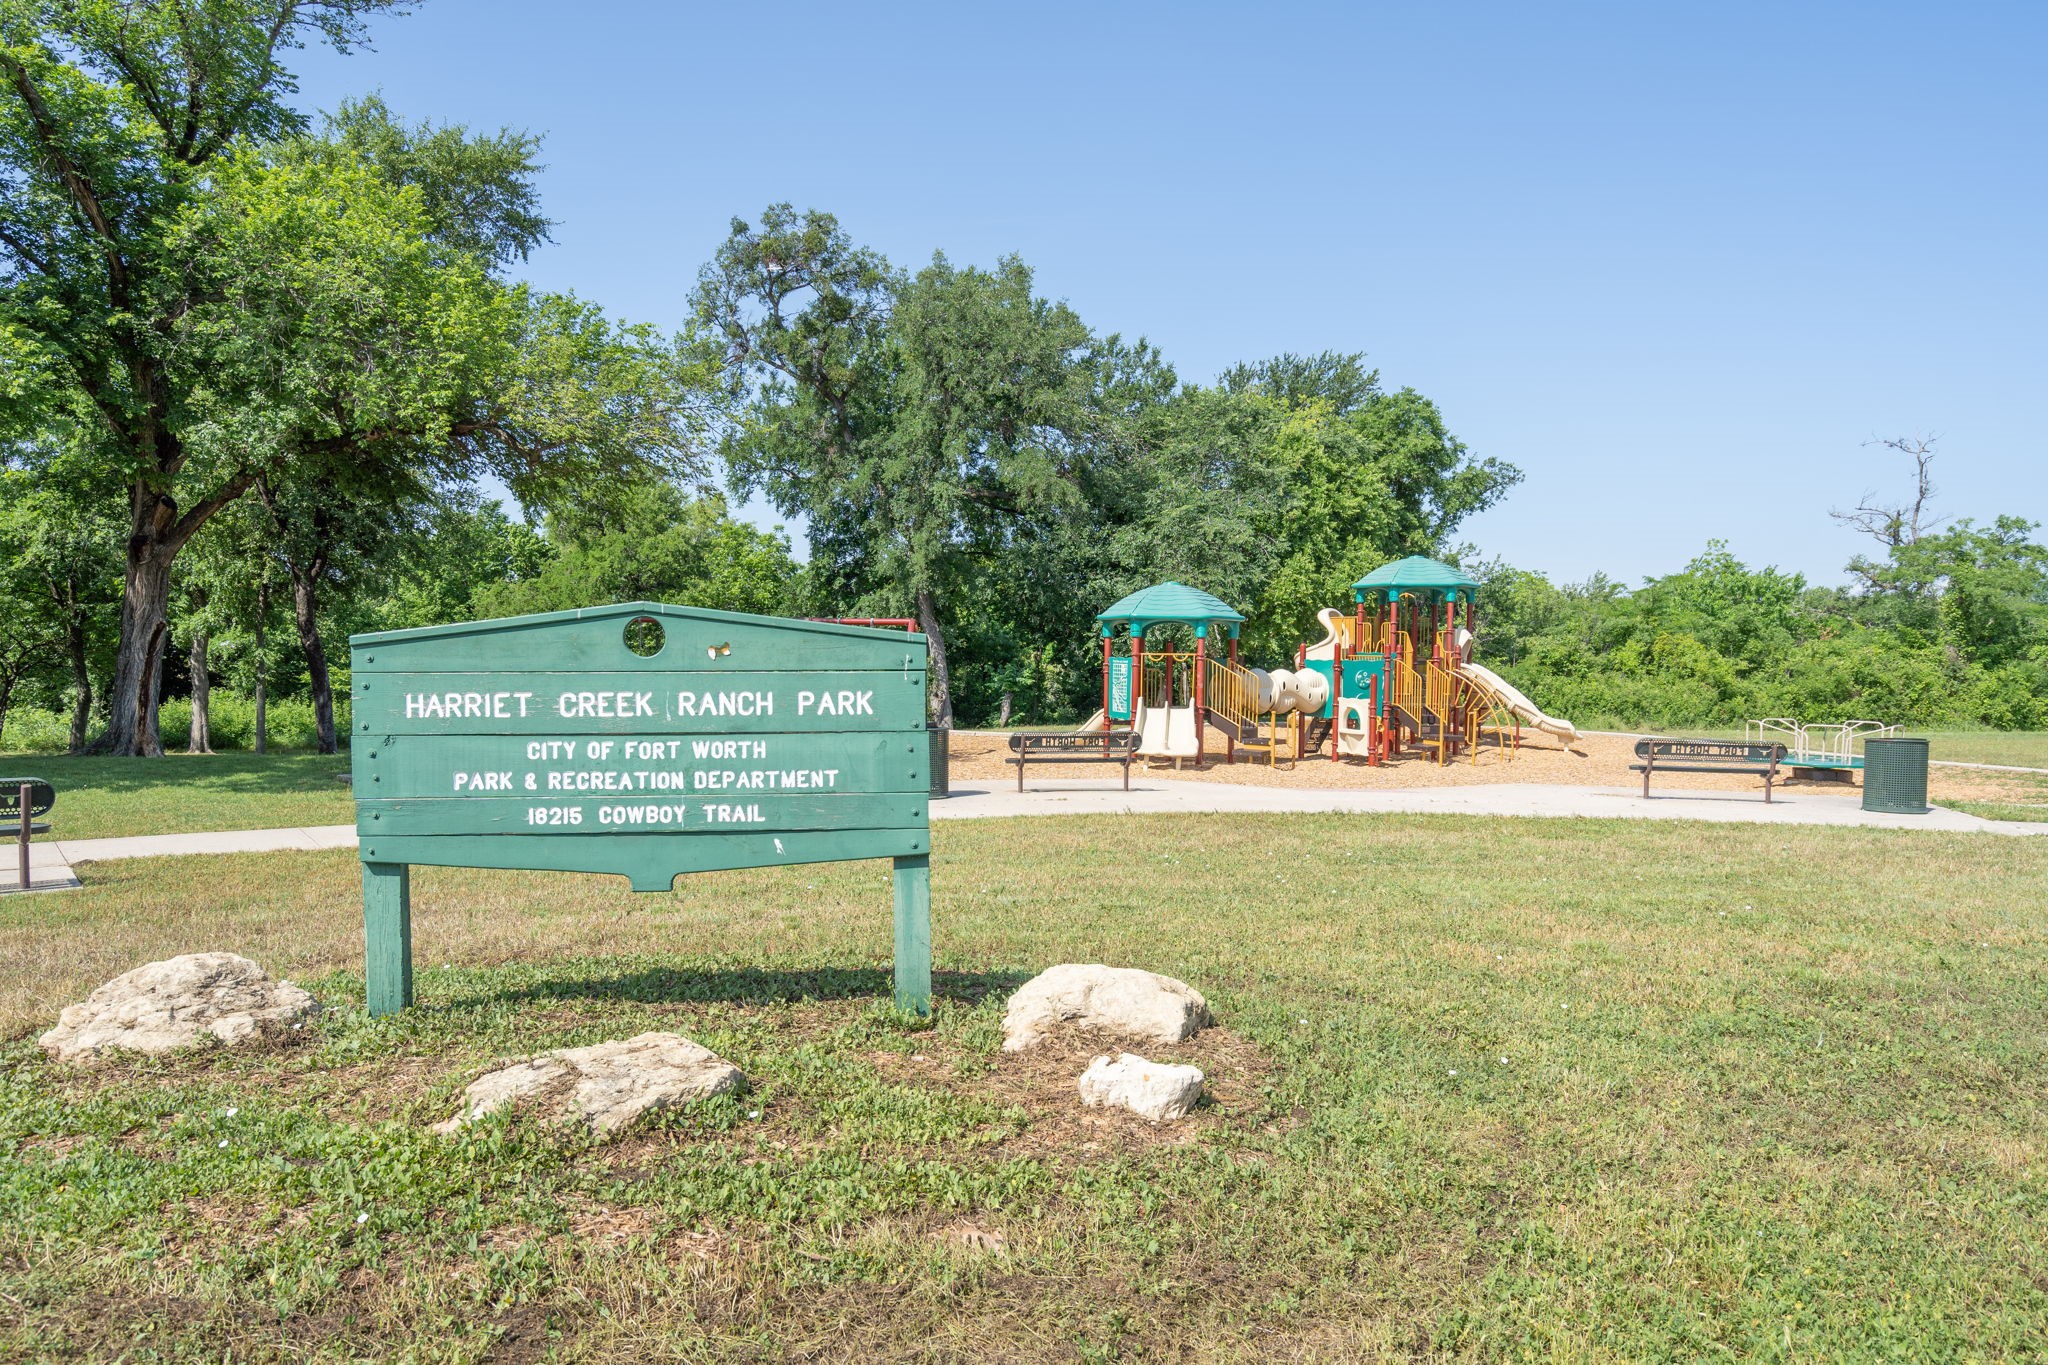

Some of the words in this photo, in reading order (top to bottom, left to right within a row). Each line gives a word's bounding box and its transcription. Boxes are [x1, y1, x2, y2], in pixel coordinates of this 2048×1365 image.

[405, 692, 533, 719] HARRIET
[559, 691, 654, 718] CREEK
[678, 691, 773, 717] RANCH
[798, 690, 873, 716] PARK
[527, 741, 576, 760] CITY
[587, 741, 614, 760] OF
[625, 741, 681, 760] FORT
[691, 740, 766, 759] WORTH
[454, 771, 513, 791] PARK
[524, 772, 537, 790] &
[548, 771, 684, 790] RECREATION
[694, 769, 839, 789] DEPARTMENT
[598, 805, 686, 825] COWBOY
[702, 804, 766, 823] TRAIL
